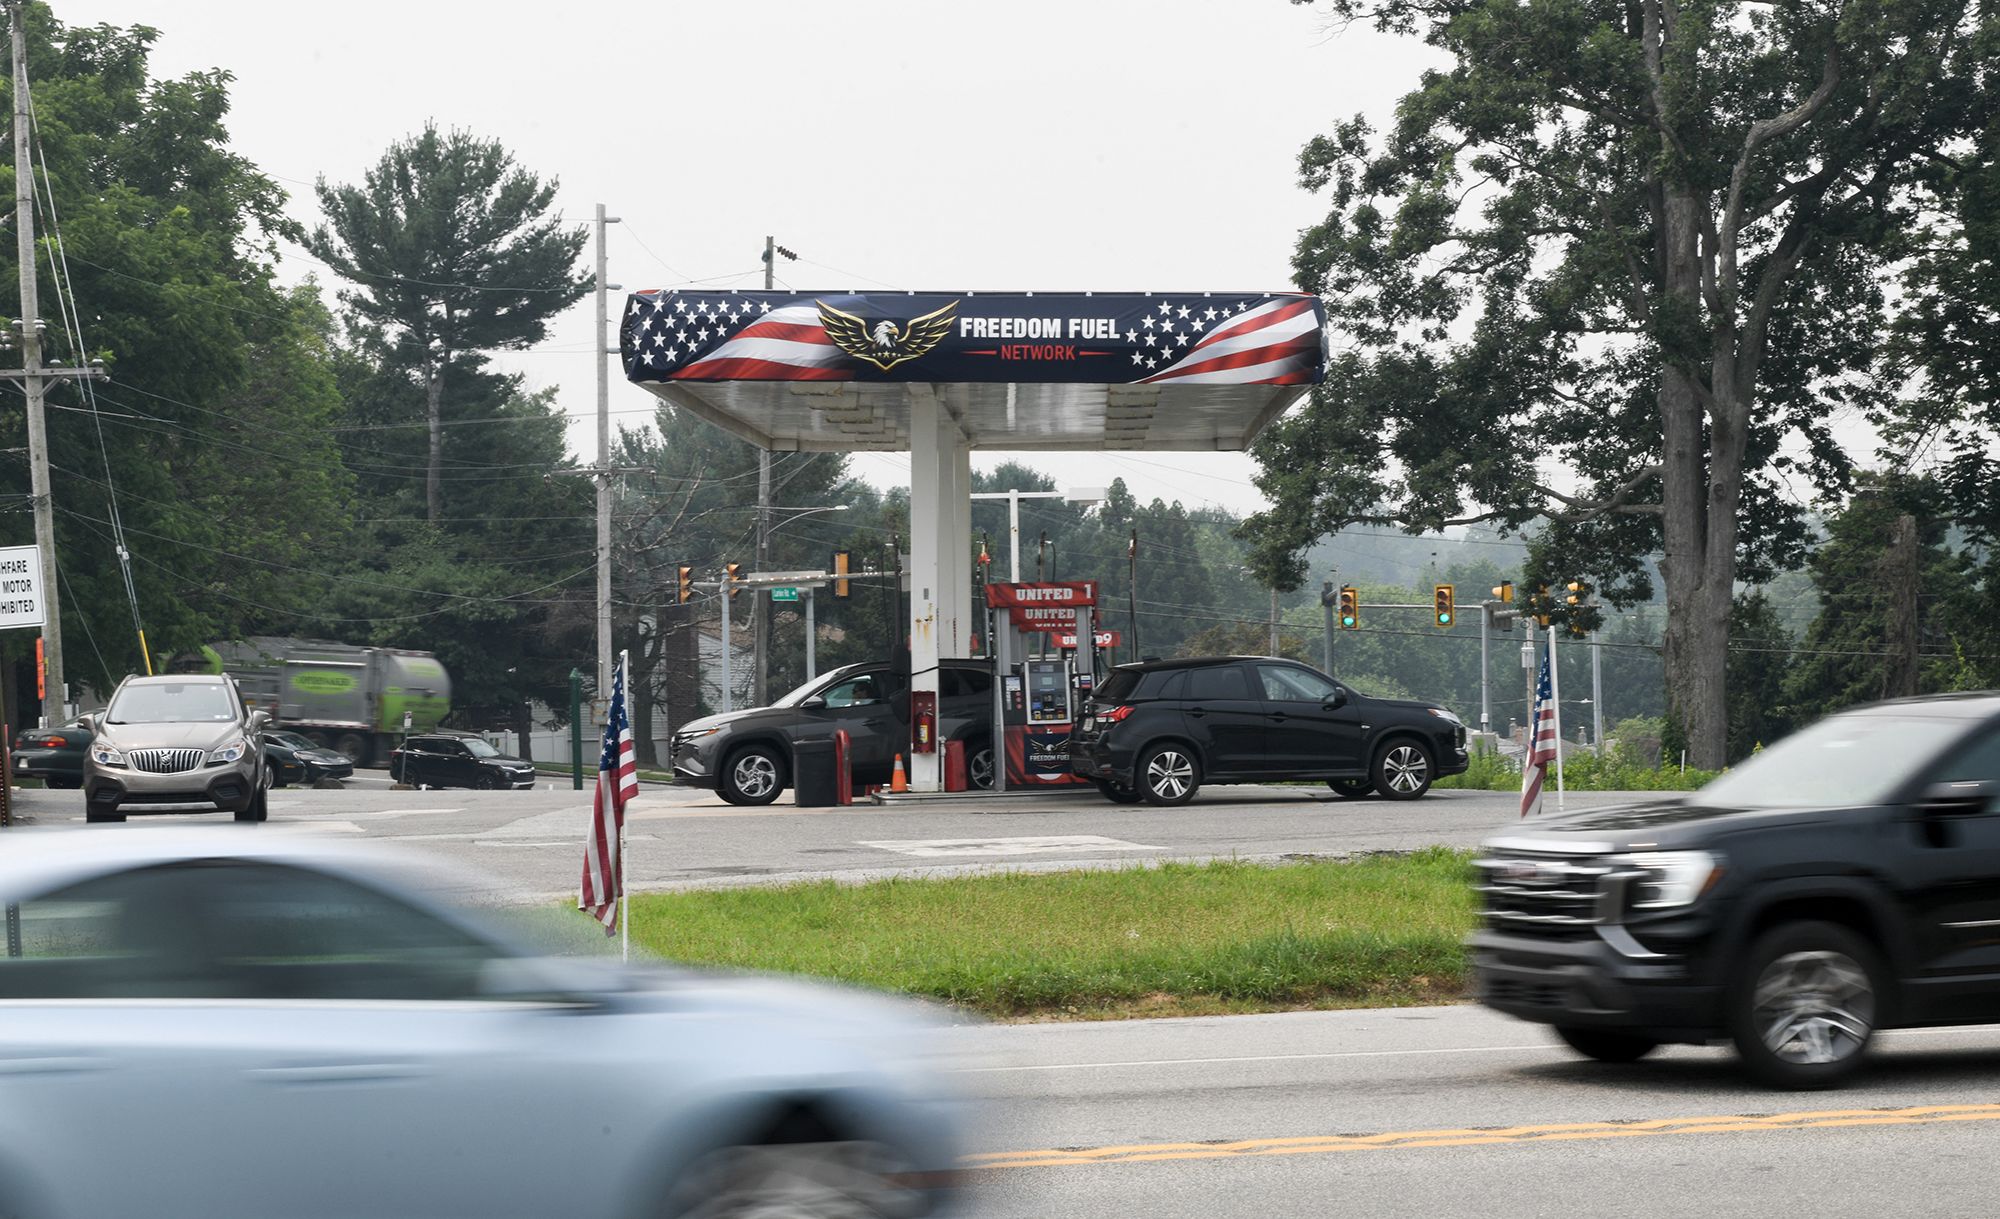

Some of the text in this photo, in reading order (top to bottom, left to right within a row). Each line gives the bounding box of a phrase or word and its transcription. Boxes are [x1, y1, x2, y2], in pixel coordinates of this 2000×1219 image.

[960, 317, 1121, 339] FREEDOM FUEL
[1001, 345, 1076, 361] NETWORK
[0, 560, 27, 574] HFARE
[3, 579, 32, 593] MOTOR
[1015, 584, 1092, 601] UNITED 1
[0, 600, 34, 614] HIBITED
[1025, 608, 1076, 620] UNITED
[1062, 633, 1113, 645] UND 9
[1072, 676, 1079, 688] 1
